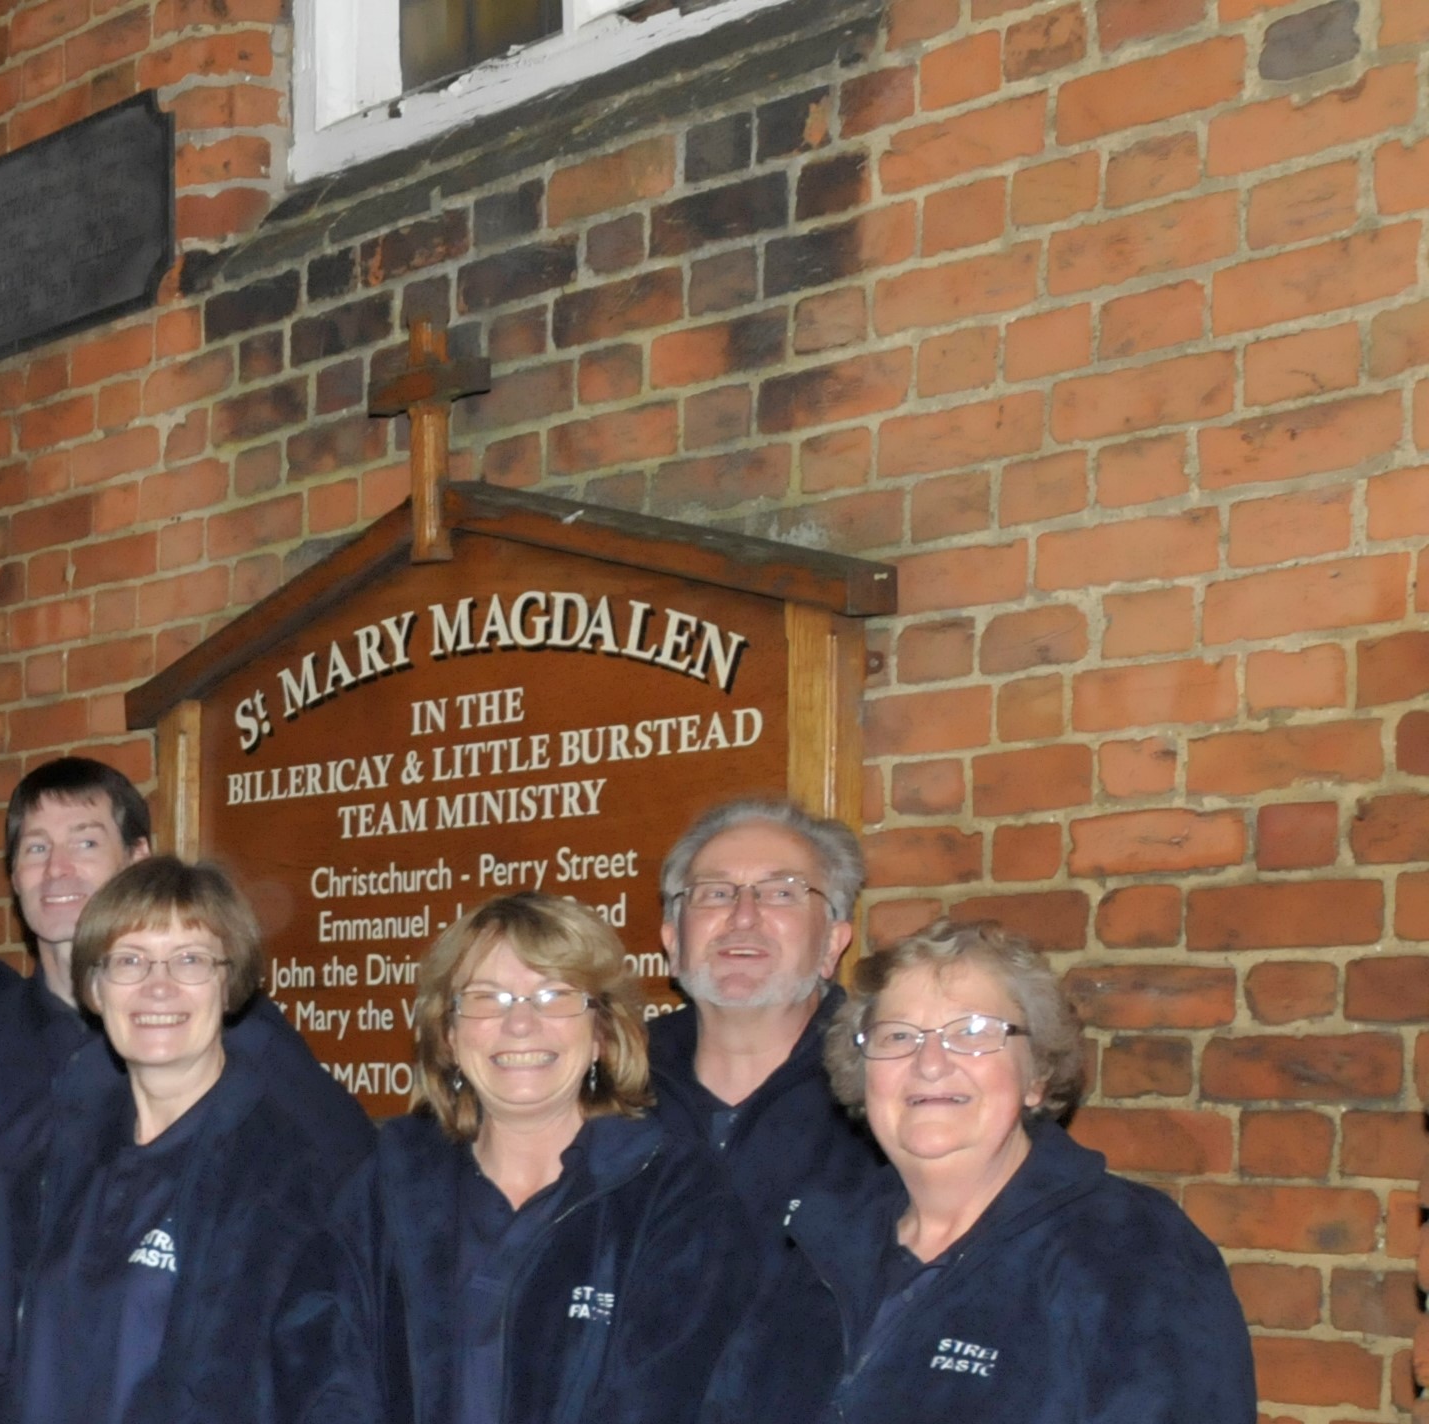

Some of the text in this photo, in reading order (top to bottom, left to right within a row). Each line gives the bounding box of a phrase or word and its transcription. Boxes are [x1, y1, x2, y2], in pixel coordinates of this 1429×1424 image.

[277, 611, 415, 718] MARY
[428, 590, 746, 690] MAGDALEN
[411, 687, 525, 736] IN THE
[227, 707, 763, 806] BILLERICAY & LITTLE BURSTEAD
[338, 778, 607, 839] TEAM MINISTRY
[311, 858, 452, 898] Christchurch
[479, 853, 548, 890] Perry
[557, 847, 639, 882] Street
[319, 905, 429, 943] Emmanuel
[269, 957, 315, 998] John
[323, 955, 358, 987] the
[295, 1000, 351, 1041] Mary
[357, 999, 394, 1031] the
